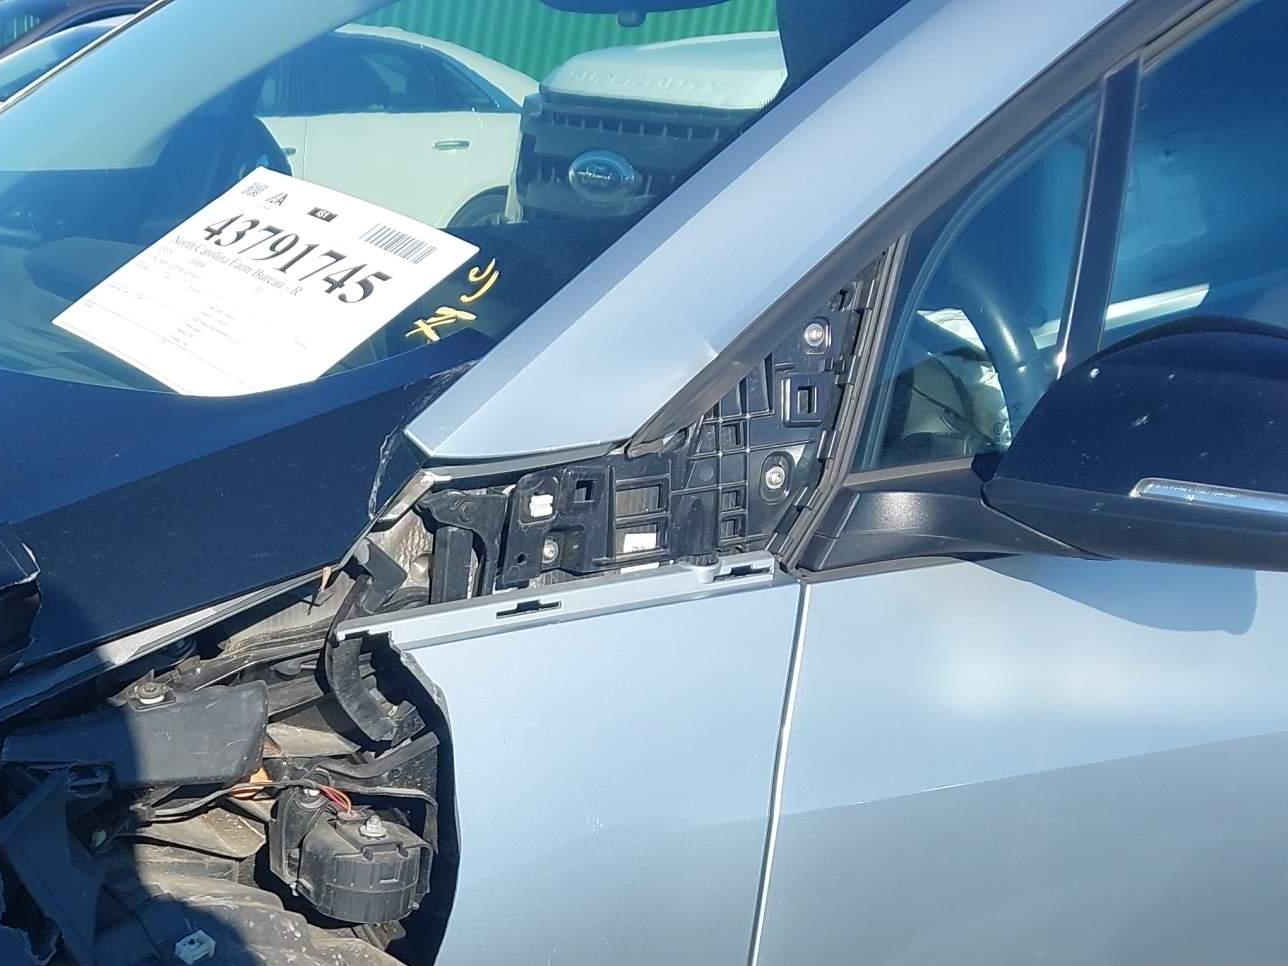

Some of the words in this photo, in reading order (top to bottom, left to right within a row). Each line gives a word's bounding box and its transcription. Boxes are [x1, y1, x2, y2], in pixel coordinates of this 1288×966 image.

[193, 241, 230, 265] Carolina
[227, 258, 253, 275] Farm
[252, 268, 285, 289] Bureau
[203, 213, 392, 304] 43791745
